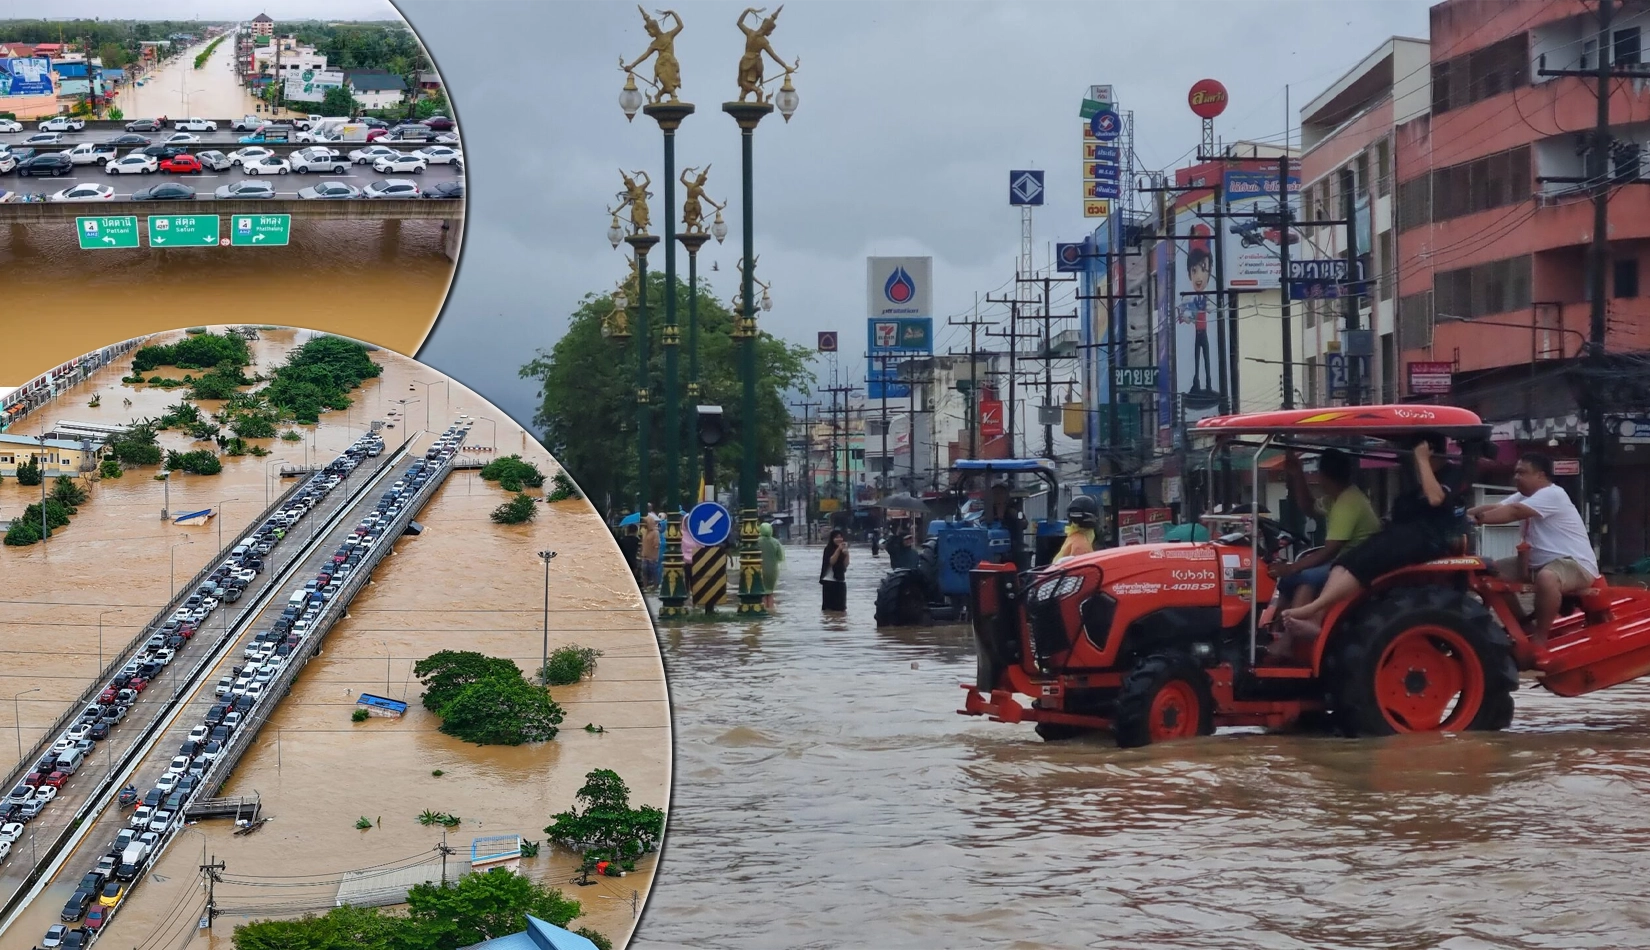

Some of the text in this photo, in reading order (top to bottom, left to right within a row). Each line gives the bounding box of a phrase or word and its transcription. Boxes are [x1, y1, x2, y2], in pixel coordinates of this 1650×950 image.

[102, 217, 132, 227] ปัตตานี
[175, 217, 196, 228] สตูล
[260, 216, 282, 227] พัทลุง
[1172, 569, 1215, 580] Kubota
